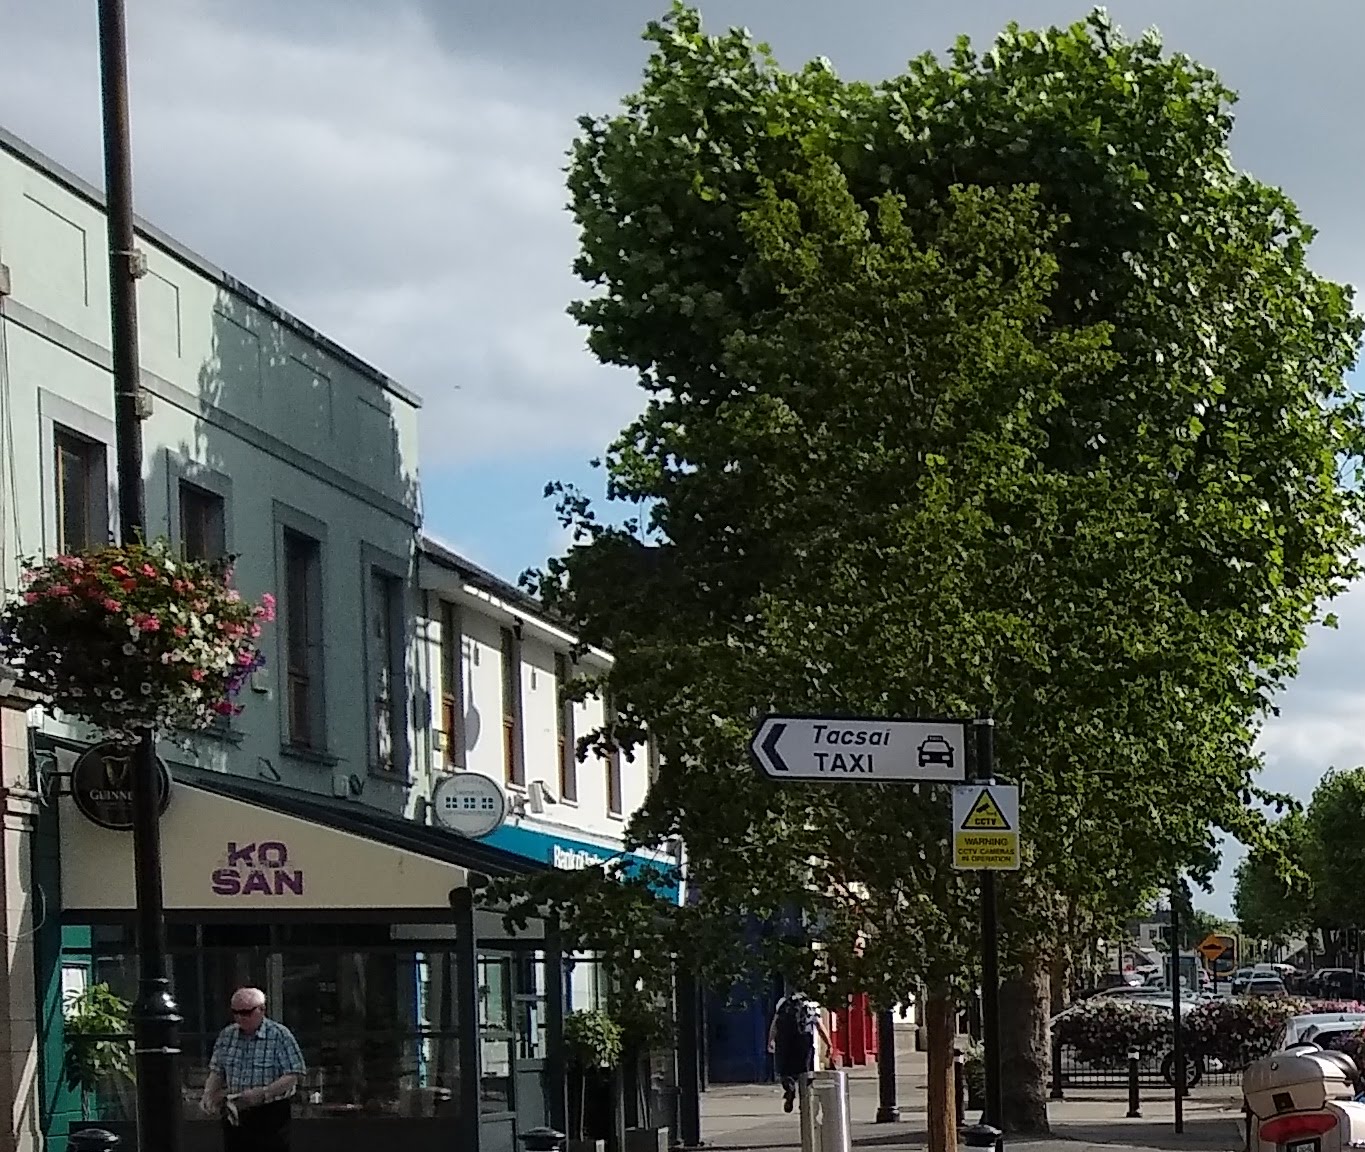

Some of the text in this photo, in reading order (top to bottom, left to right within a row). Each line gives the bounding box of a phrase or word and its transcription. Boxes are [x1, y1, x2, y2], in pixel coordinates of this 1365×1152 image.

[813, 752, 873, 773] TAXI
[974, 817, 997, 826] CCTV
[964, 837, 1008, 847] WARNING
[227, 841, 288, 868] KO
[211, 868, 303, 896] SAN
